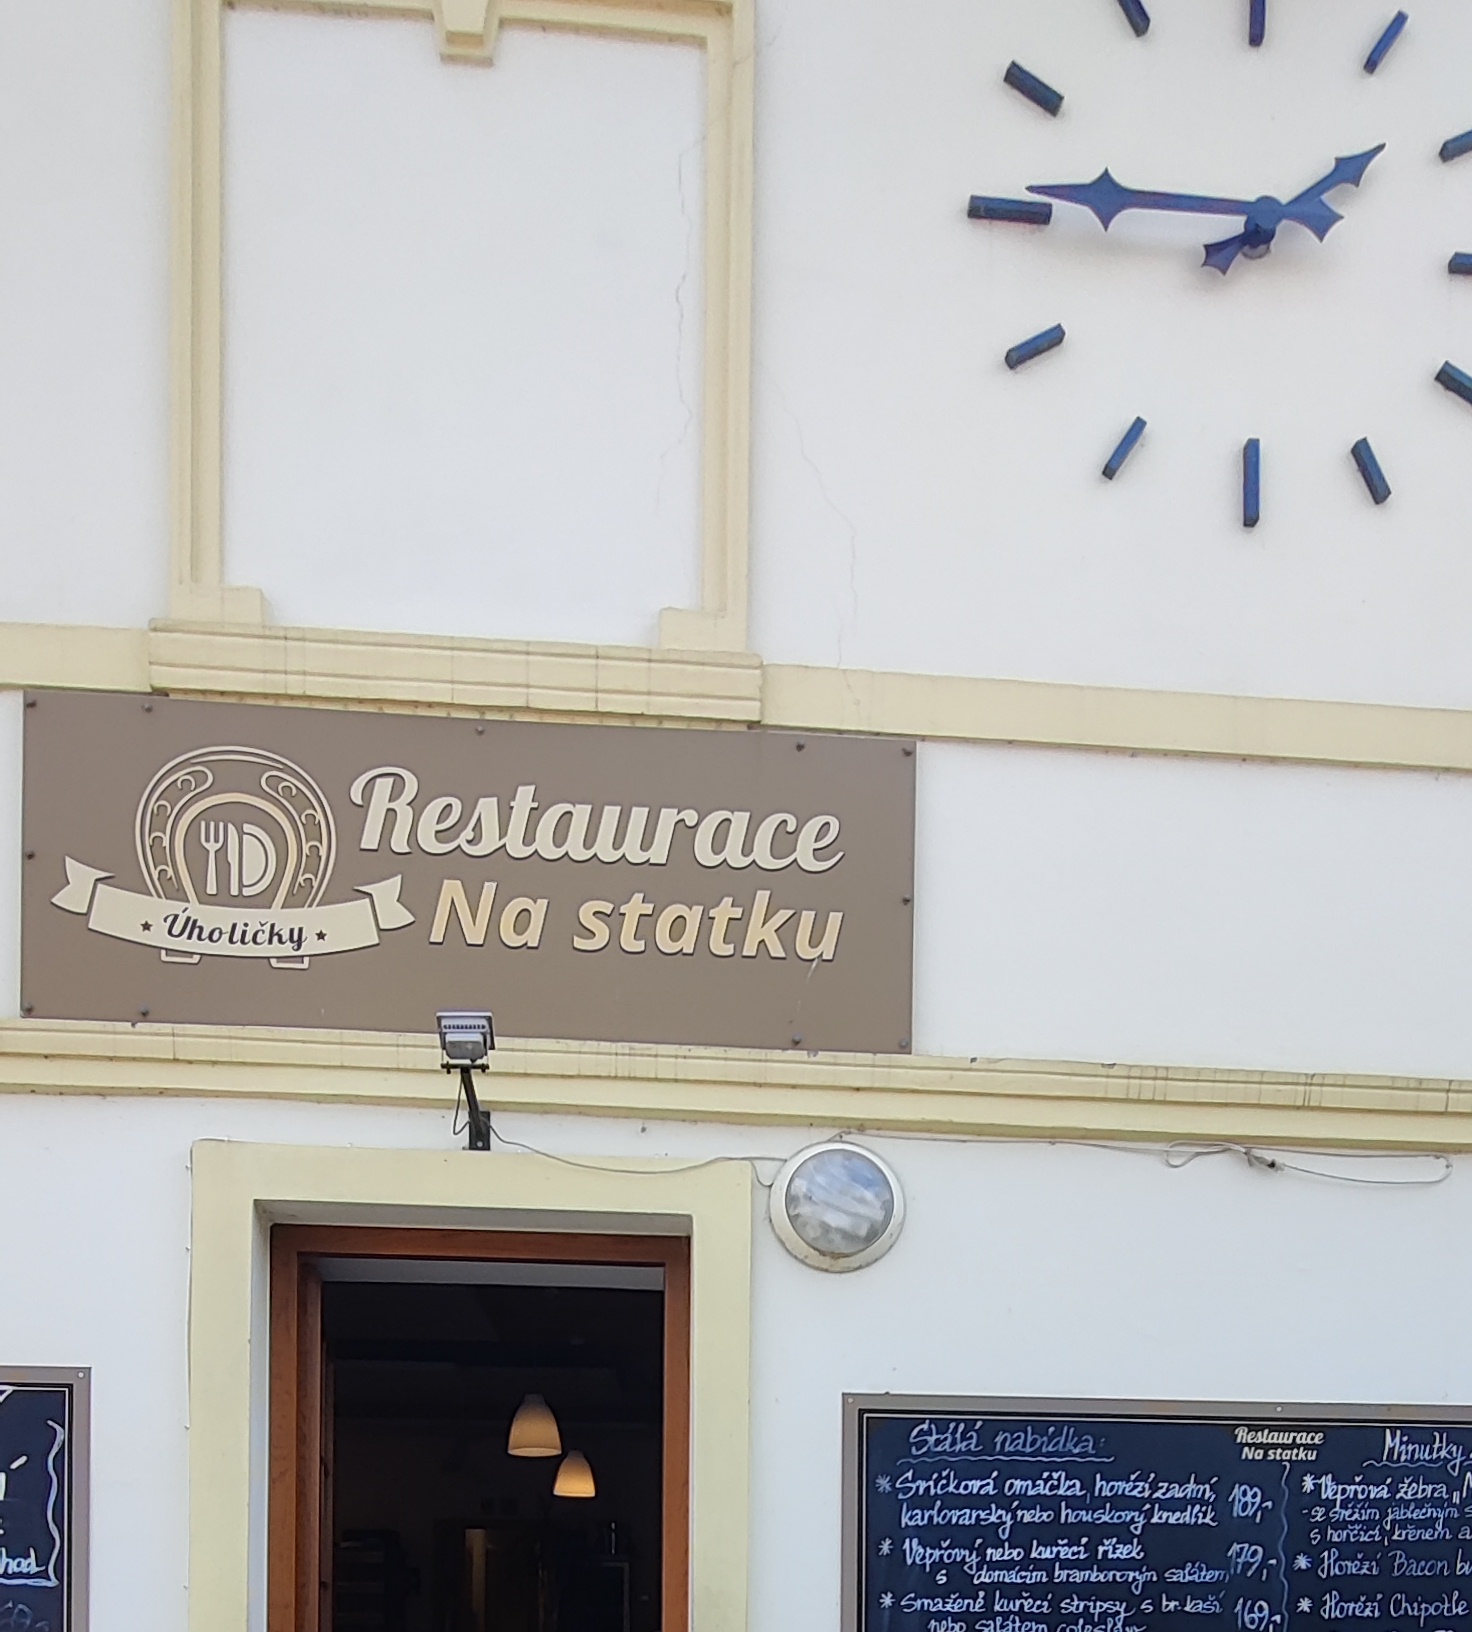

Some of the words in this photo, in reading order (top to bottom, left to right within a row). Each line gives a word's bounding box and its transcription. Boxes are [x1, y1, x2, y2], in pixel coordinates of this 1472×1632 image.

[350, 765, 844, 873] Restaurace
[163, 906, 308, 952] Úholičky
[429, 878, 551, 949] Na
[572, 890, 845, 962] statku
[909, 1419, 984, 1456] Stálá
[1235, 1426, 1325, 1445] Restaurace
[1241, 1447, 1264, 1461] Na
[1267, 1446, 1318, 1461] statku
[895, 1468, 998, 1500] Svíčková
[1094, 1471, 1155, 1498] hovězí
[1319, 1473, 1392, 1509] Vepřová
[1395, 1475, 1449, 1500] žebra
[901, 1500, 1019, 1540] karlovarský
[1017, 1504, 1055, 1523] nebo
[1061, 1501, 1151, 1535] houskový
[1382, 1502, 1460, 1530] jablečným
[1310, 1529, 1321, 1545] s
[902, 1537, 981, 1575] Vepřový
[986, 1541, 1025, 1562] nebo
[1030, 1539, 1090, 1560] kuřecí
[1097, 1537, 1145, 1560] řízek
[1388, 1550, 1451, 1577] Bacon
[935, 1568, 949, 1585] s
[973, 1564, 1050, 1585] domácím
[1053, 1561, 1158, 1596] bramborovým
[900, 1590, 986, 1613] Smažené
[993, 1590, 1053, 1613] kuřecí
[1060, 1593, 1136, 1623] stripsy
[1140, 1599, 1154, 1614] s
[1389, 1590, 1470, 1628] Chipotle
